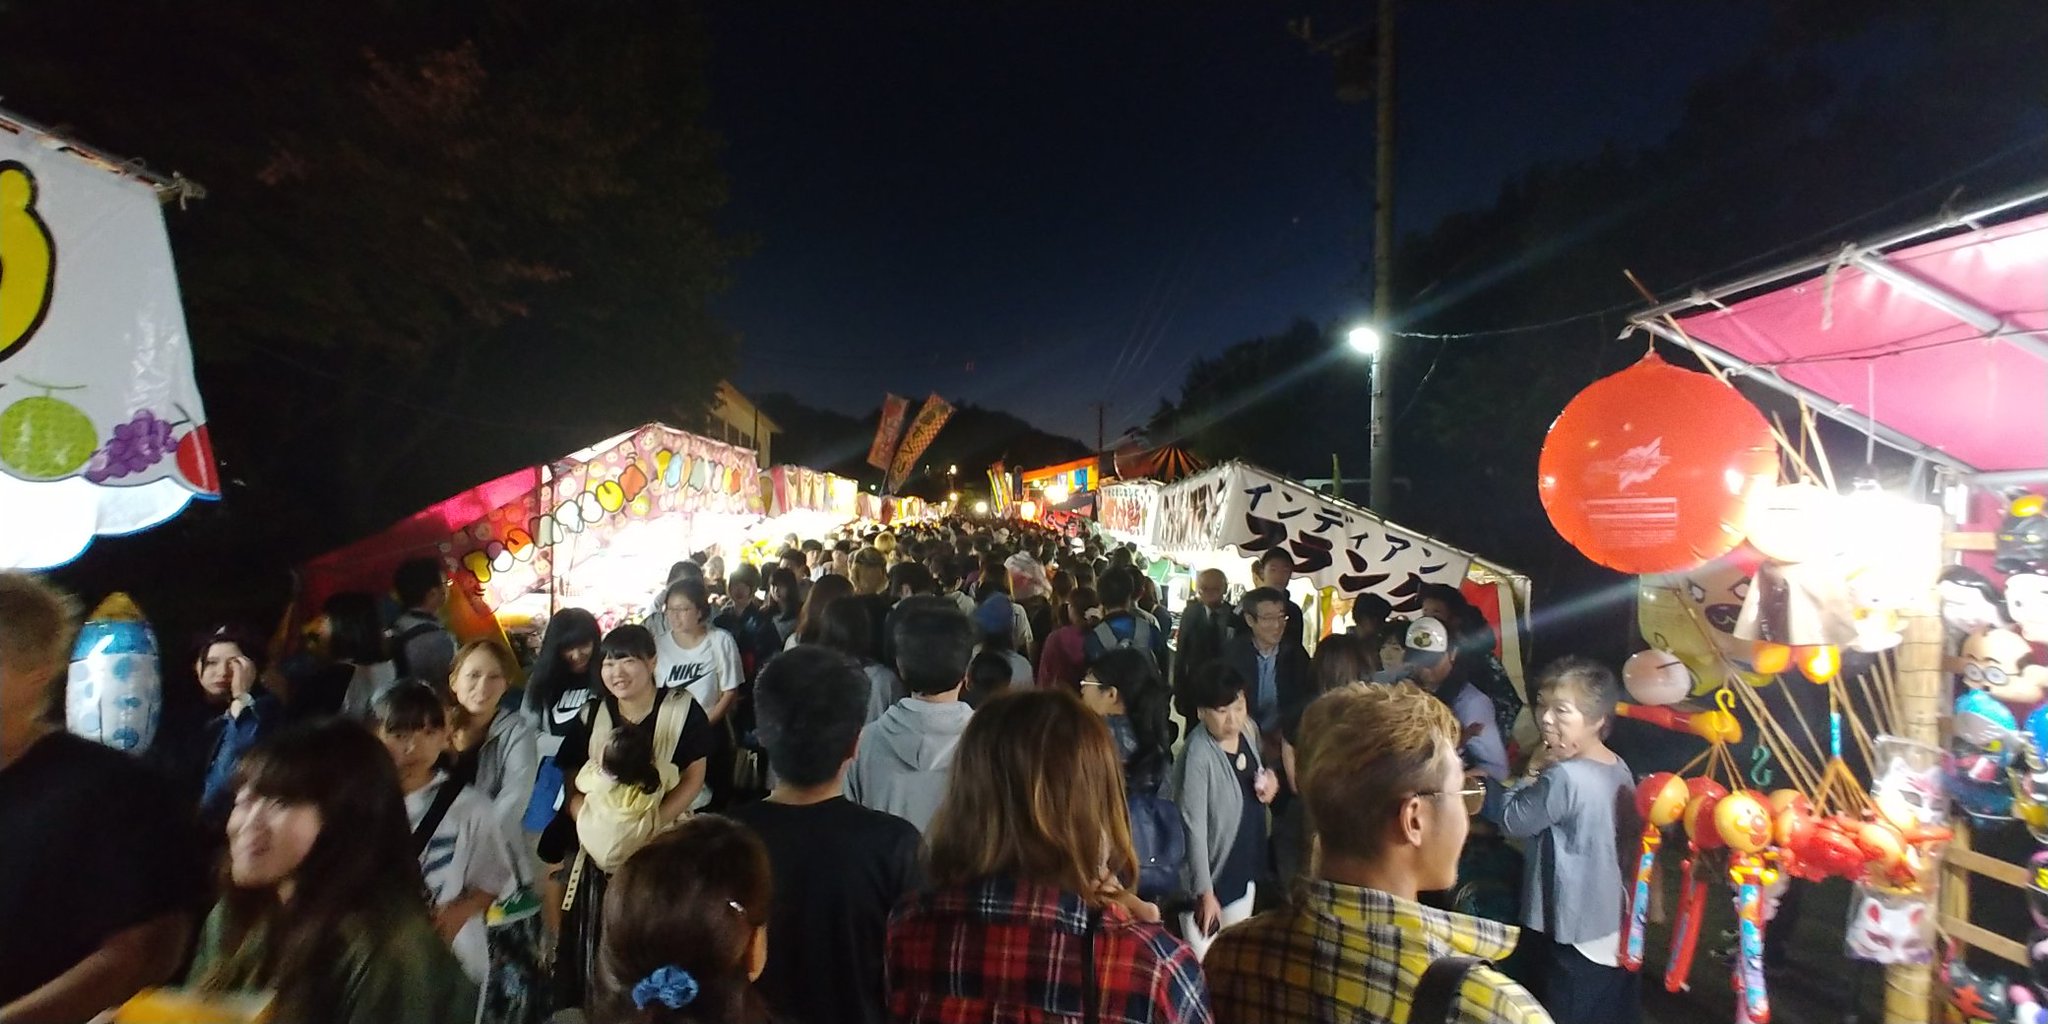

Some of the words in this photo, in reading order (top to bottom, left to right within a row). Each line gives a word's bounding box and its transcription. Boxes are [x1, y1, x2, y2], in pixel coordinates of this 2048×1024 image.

[1244, 484, 1448, 574] インディアン
[668, 662, 704, 681] NIKE
[558, 688, 591, 709] NIK
